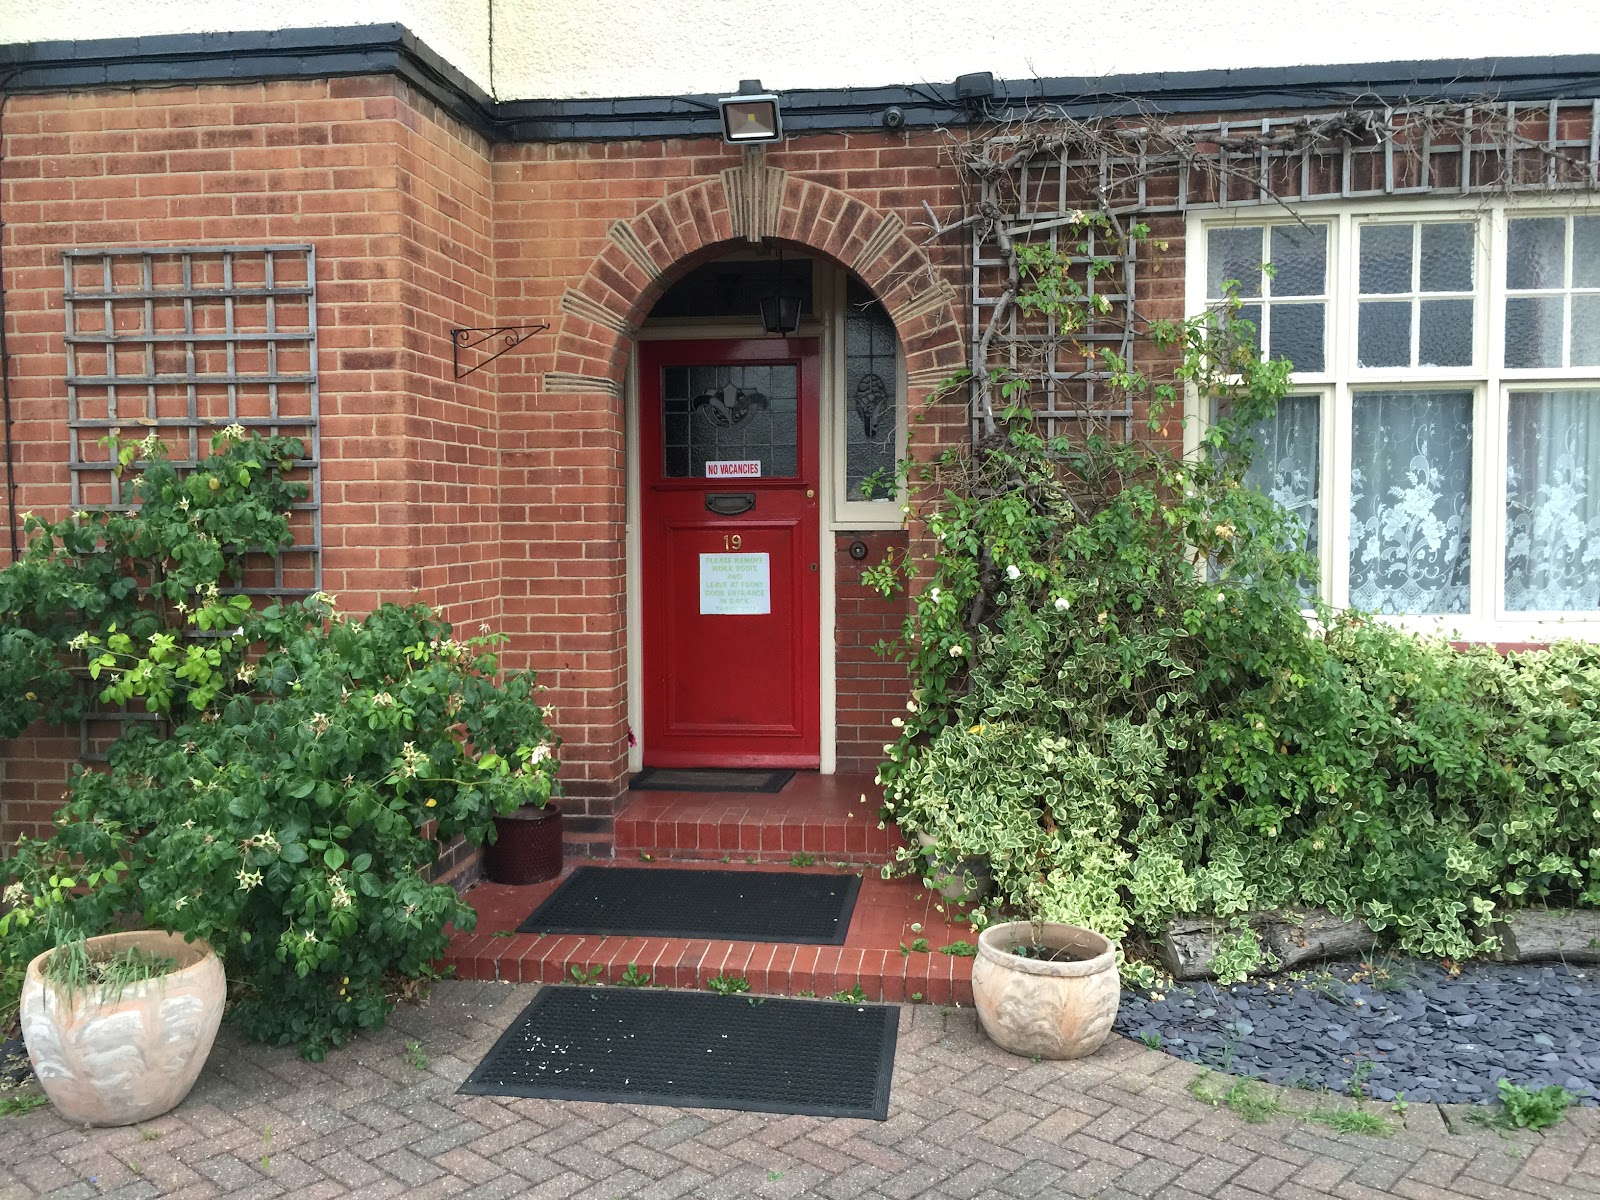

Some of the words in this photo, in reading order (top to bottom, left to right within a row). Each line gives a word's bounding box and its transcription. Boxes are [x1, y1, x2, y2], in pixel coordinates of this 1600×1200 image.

[708, 464, 718, 475] NO
[721, 463, 759, 474] VACANCIES
[723, 534, 742, 551] 19
